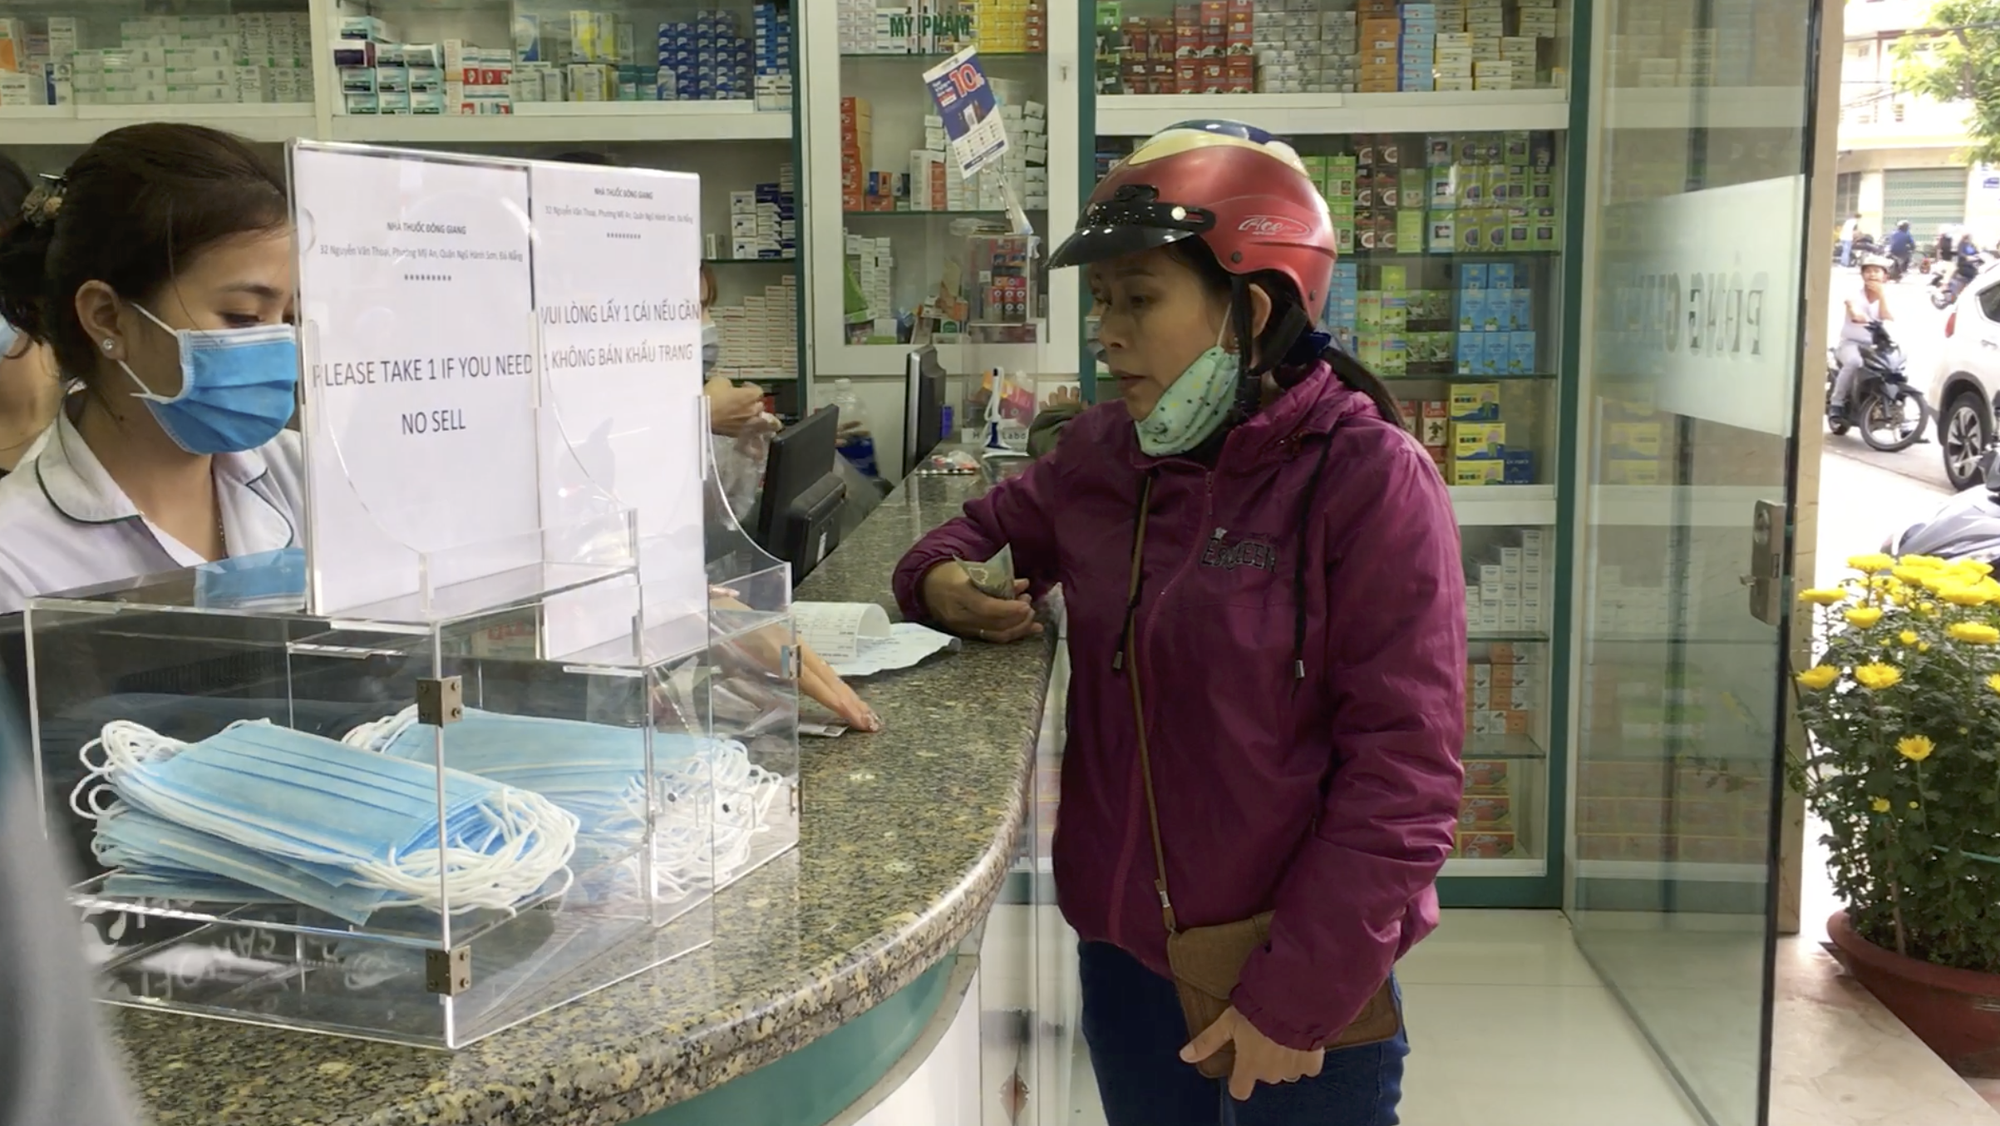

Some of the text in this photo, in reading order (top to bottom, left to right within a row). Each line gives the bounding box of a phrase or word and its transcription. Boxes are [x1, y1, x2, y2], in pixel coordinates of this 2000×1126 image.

[403, 221, 425, 233] THUỐC
[426, 222, 446, 234] ĐÔNG
[446, 225, 467, 235] GIANG
[320, 244, 328, 255] 32
[565, 301, 597, 324] LÒNG
[601, 298, 621, 323] LẤY
[624, 305, 631, 322] 1
[633, 301, 650, 322] CÁI
[654, 298, 676, 321] NẾU
[552, 345, 595, 369] KHÔNG
[599, 343, 622, 366] BÁN
[659, 344, 693, 363] TRANG
[313, 354, 533, 388] PLEASE TAKE 1 IF YOU NEED
[402, 409, 466, 435] NO SELL
